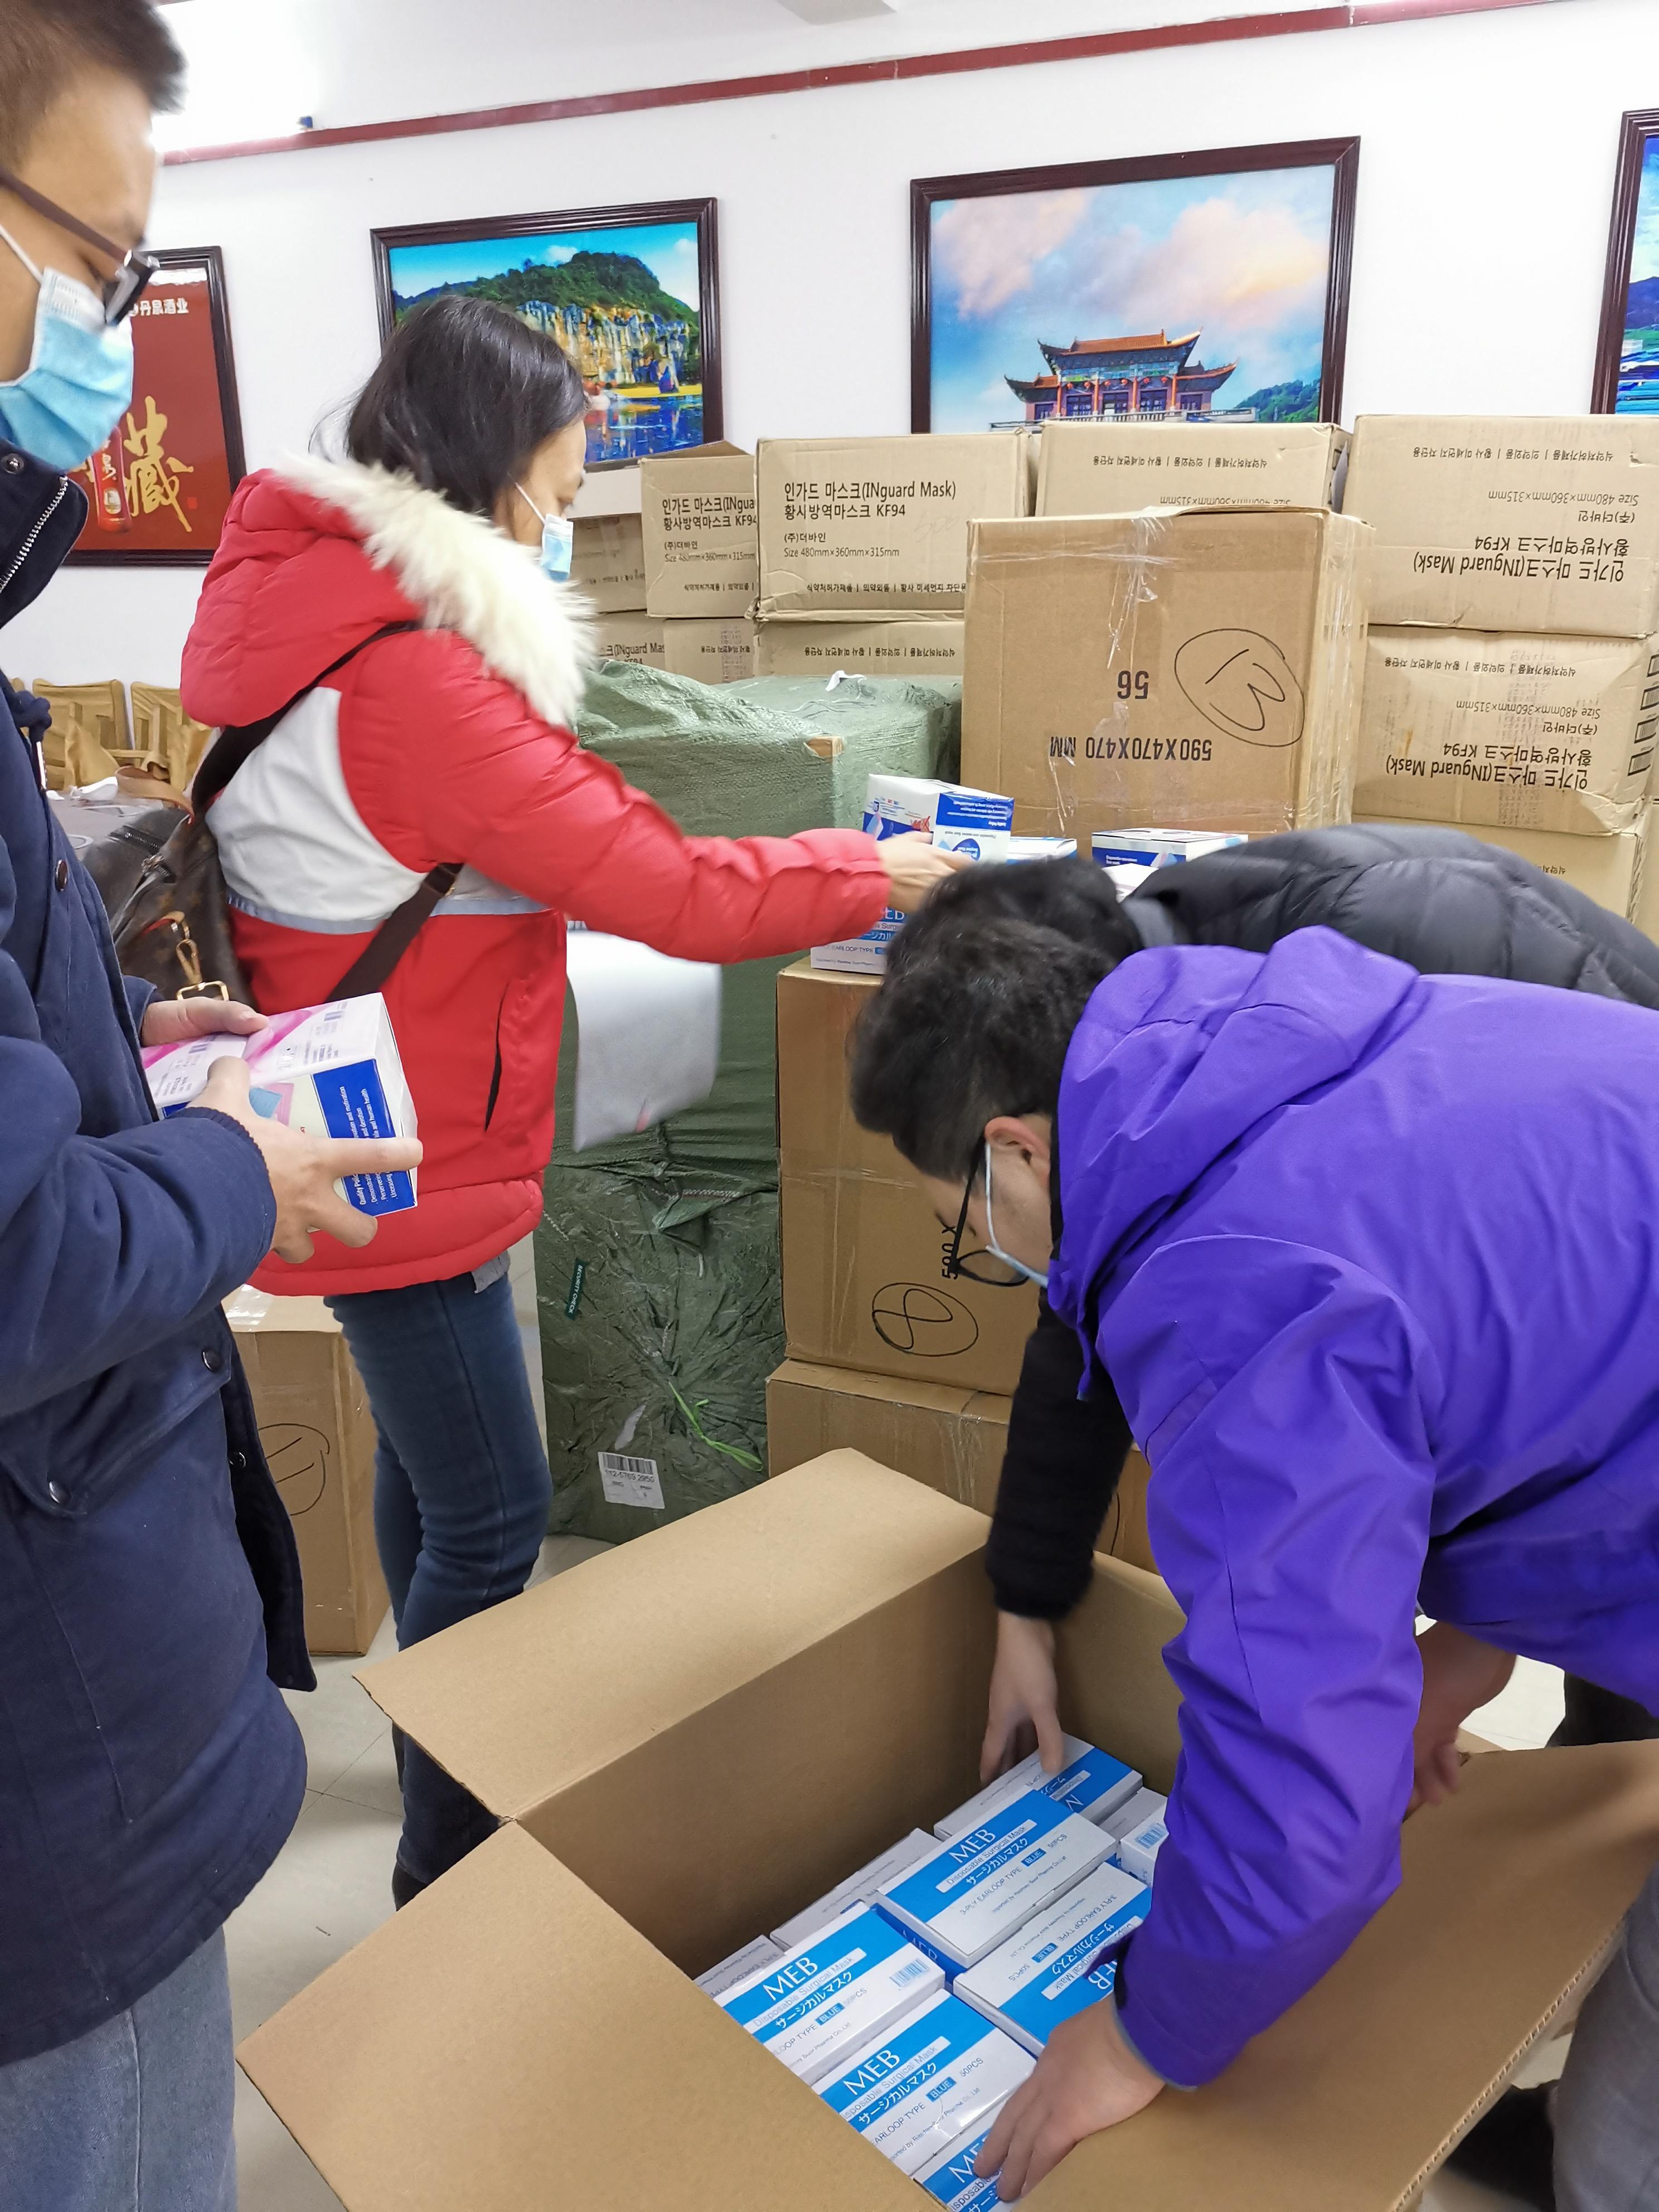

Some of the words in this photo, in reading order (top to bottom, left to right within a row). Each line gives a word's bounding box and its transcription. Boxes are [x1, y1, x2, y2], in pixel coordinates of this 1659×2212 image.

[1413, 447, 1437, 458] 차단용
[1440, 447, 1472, 458] 미세먼지
[1476, 448, 1492, 459] 황사
[1506, 448, 1539, 460] 의약외품
[784, 482, 819, 502] 인가드
[826, 481, 915, 502] 마스크(INguard
[920, 480, 956, 499] Mask)
[1618, 494, 1639, 506] Size
[662, 498, 690, 515] 인가드
[877, 505, 906, 517] KF94
[1578, 510, 1635, 523] (주)더바인
[664, 516, 731, 531] 황사방역마스크
[784, 533, 826, 542] (주)더바인
[1474, 536, 1510, 551] KF94
[1517, 536, 1629, 557] 황사방역마스크
[784, 548, 798, 557] Size
[1413, 552, 1455, 574] Mask)
[1459, 555, 1570, 581] 마스크(INguard
[1579, 559, 1624, 583] 인가드
[1444, 660, 1460, 672] 황사
[1117, 671, 1149, 700] 56
[1581, 707, 1600, 719] Size
[1542, 721, 1598, 735] (주)더바인
[1050, 736, 1076, 758] MM
[1443, 743, 1478, 758] KF94
[1485, 744, 1592, 768] 황사방역마스크
[1385, 755, 1425, 777] Mask)
[1429, 760, 1536, 786] 마스크(INguard
[1544, 768, 1588, 790] 인가드
[574, 1264, 583, 1293] SECURITY
[569, 1293, 578, 1314] CHECK
[946, 1855, 983, 1886] Disposable
[983, 1836, 1010, 1859] Surgical
[1008, 1823, 1027, 1841] Mask
[949, 1824, 997, 1866] MEB
[965, 1836, 1029, 1888] サージカルマスク
[976, 1876, 1006, 1903] EARLOOP
[1005, 1865, 1022, 1880] TYPE
[1024, 1849, 1043, 1865] BLUE
[1072, 1905, 1101, 1930] EARLOOP
[1056, 1926, 1075, 1943] TYPE
[1035, 1943, 1055, 1961] BLUE
[1048, 1919, 1116, 1976] サージカルマスク
[761, 1953, 821, 2002] MEB
[1052, 1971, 1074, 1991] Mask
[753, 1992, 801, 2029] Disposable
[798, 1970, 833, 1998] Surgical
[831, 1954, 855, 1974] Mask
[773, 1970, 856, 2031] サージカルマスク
[796, 2022, 818, 2040] TYPE
[819, 2005, 841, 2024] BLUE
[843, 2045, 901, 2098] MEB
[881, 2061, 916, 2091] Surgical
[914, 2044, 938, 2066] Mask
[858, 2060, 939, 2127] サージカルマスク
[904, 2101, 925, 2120] TYPE
[929, 2079, 952, 2099] BLUE
